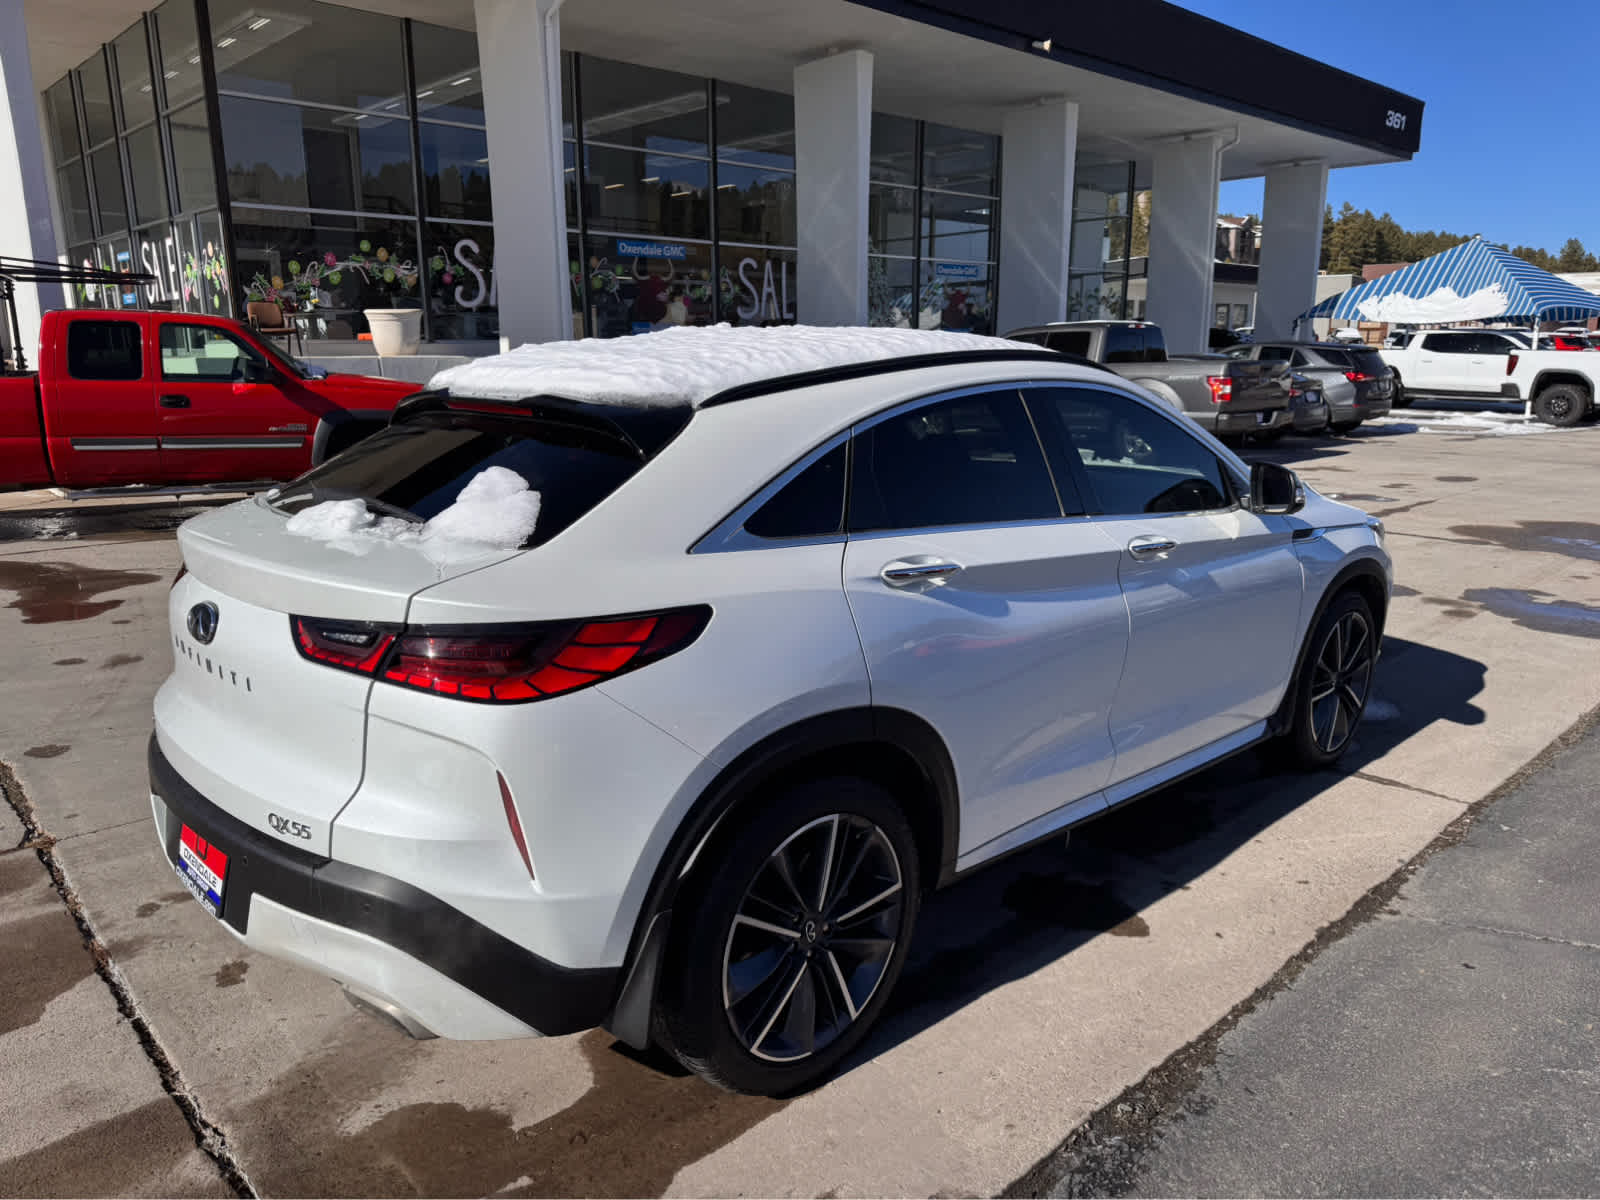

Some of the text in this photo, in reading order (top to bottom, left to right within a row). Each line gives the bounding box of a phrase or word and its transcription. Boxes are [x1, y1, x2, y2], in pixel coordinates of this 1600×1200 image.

[1385, 110, 1407, 131] 361
[663, 245, 685, 257] GMC
[142, 237, 179, 304] SALE
[175, 634, 252, 692] INFINITI
[268, 812, 312, 840] QX55
[183, 847, 217, 888] OXENDALE
